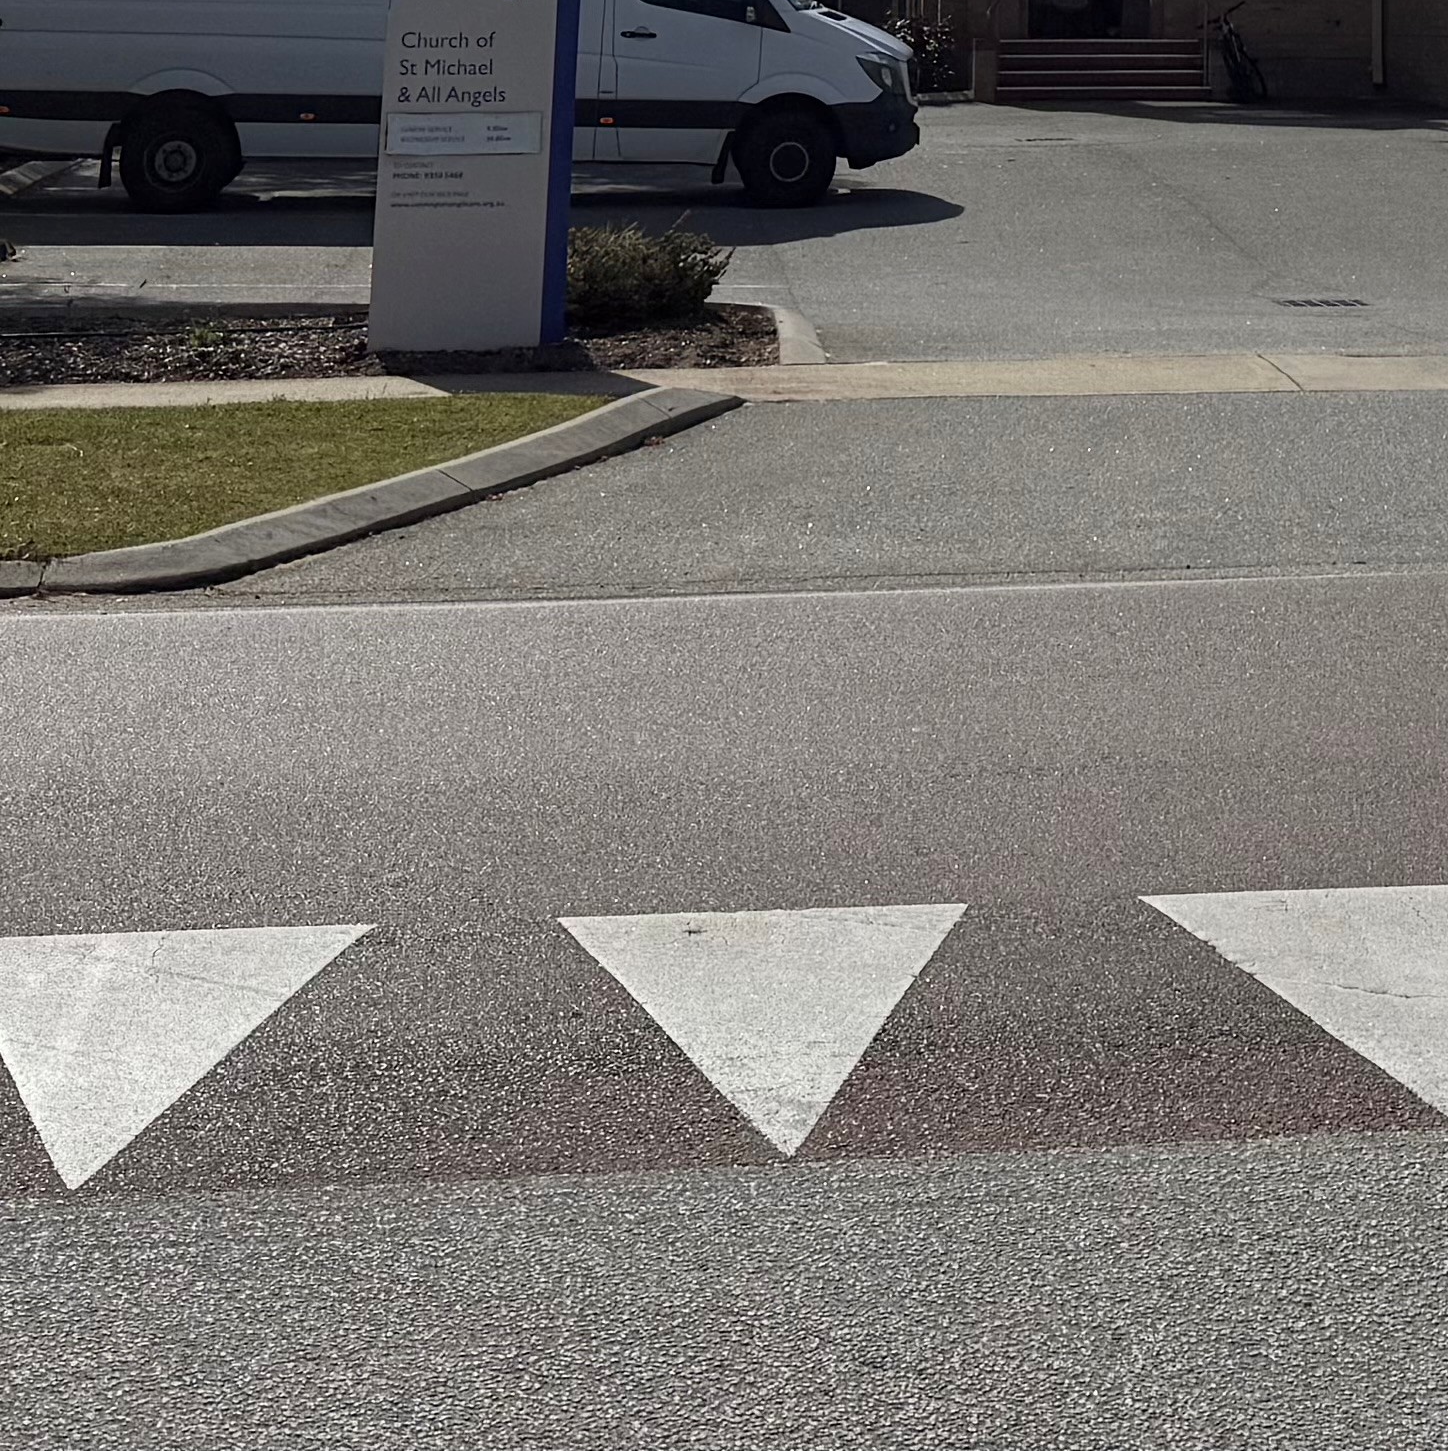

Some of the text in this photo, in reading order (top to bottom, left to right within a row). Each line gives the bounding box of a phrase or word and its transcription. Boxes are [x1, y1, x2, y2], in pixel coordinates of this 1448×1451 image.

[401, 31, 496, 48] Church of
[399, 59, 493, 75] St Michael
[397, 86, 506, 107] & All Angels
